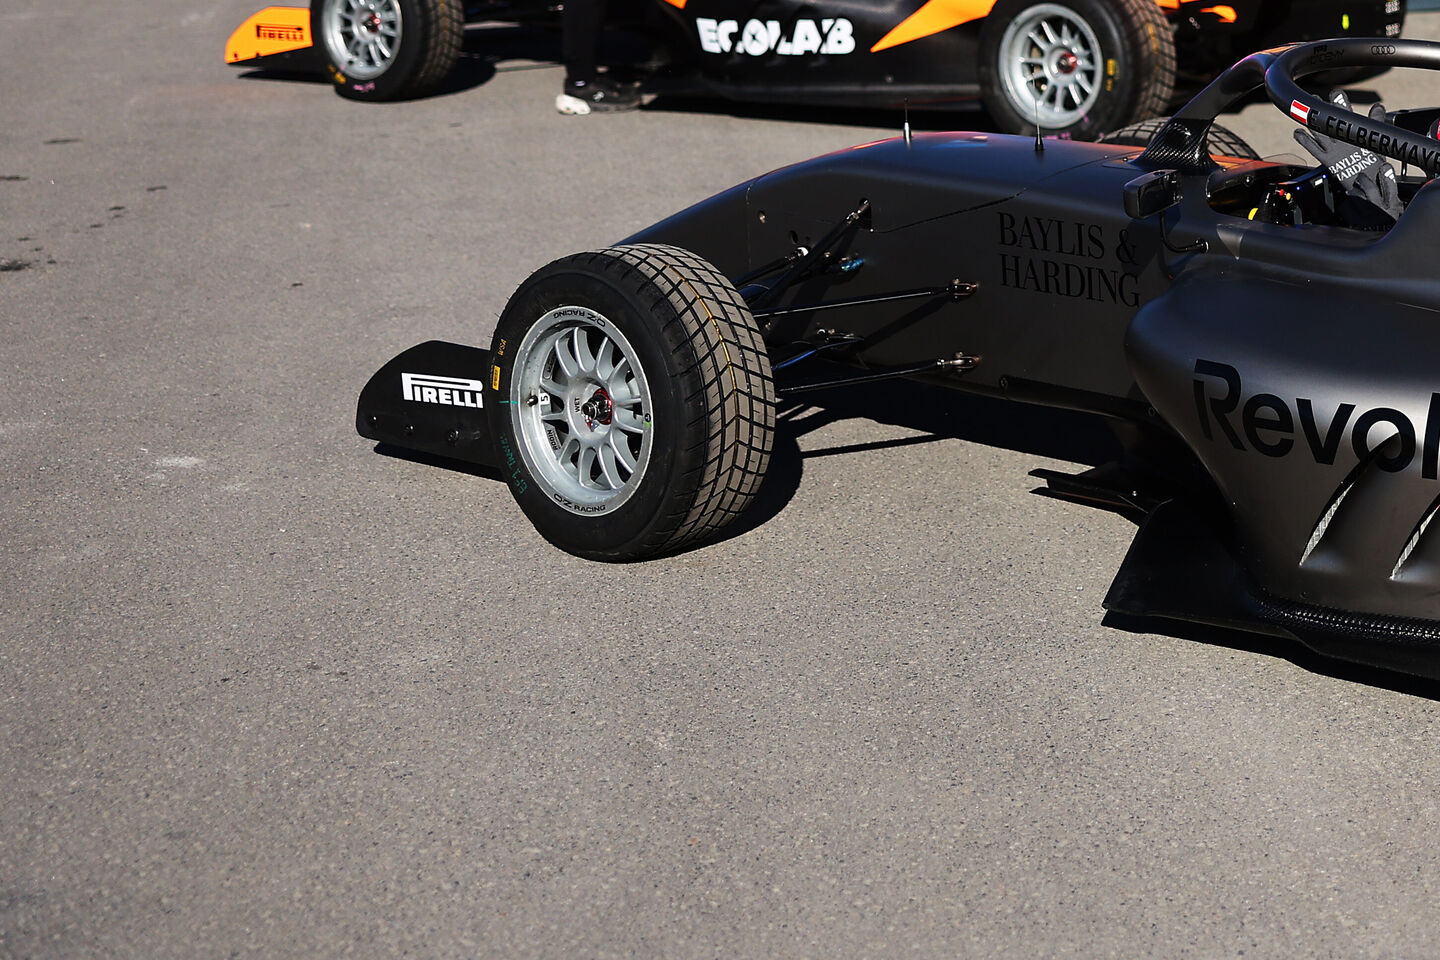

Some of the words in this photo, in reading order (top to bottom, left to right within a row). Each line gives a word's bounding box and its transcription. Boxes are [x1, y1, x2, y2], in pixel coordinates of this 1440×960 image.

[256, 24, 304, 41] PIRELLI
[696, 17, 856, 57] ECOLAB
[1329, 151, 1362, 174] BAYLIS
[998, 211, 1104, 259] BAYLIS
[1115, 228, 1139, 266] &
[999, 252, 1142, 308] HARDING
[553, 309, 585, 319] RACING
[401, 372, 484, 409] PIRELLI
[575, 504, 606, 513] RACING
